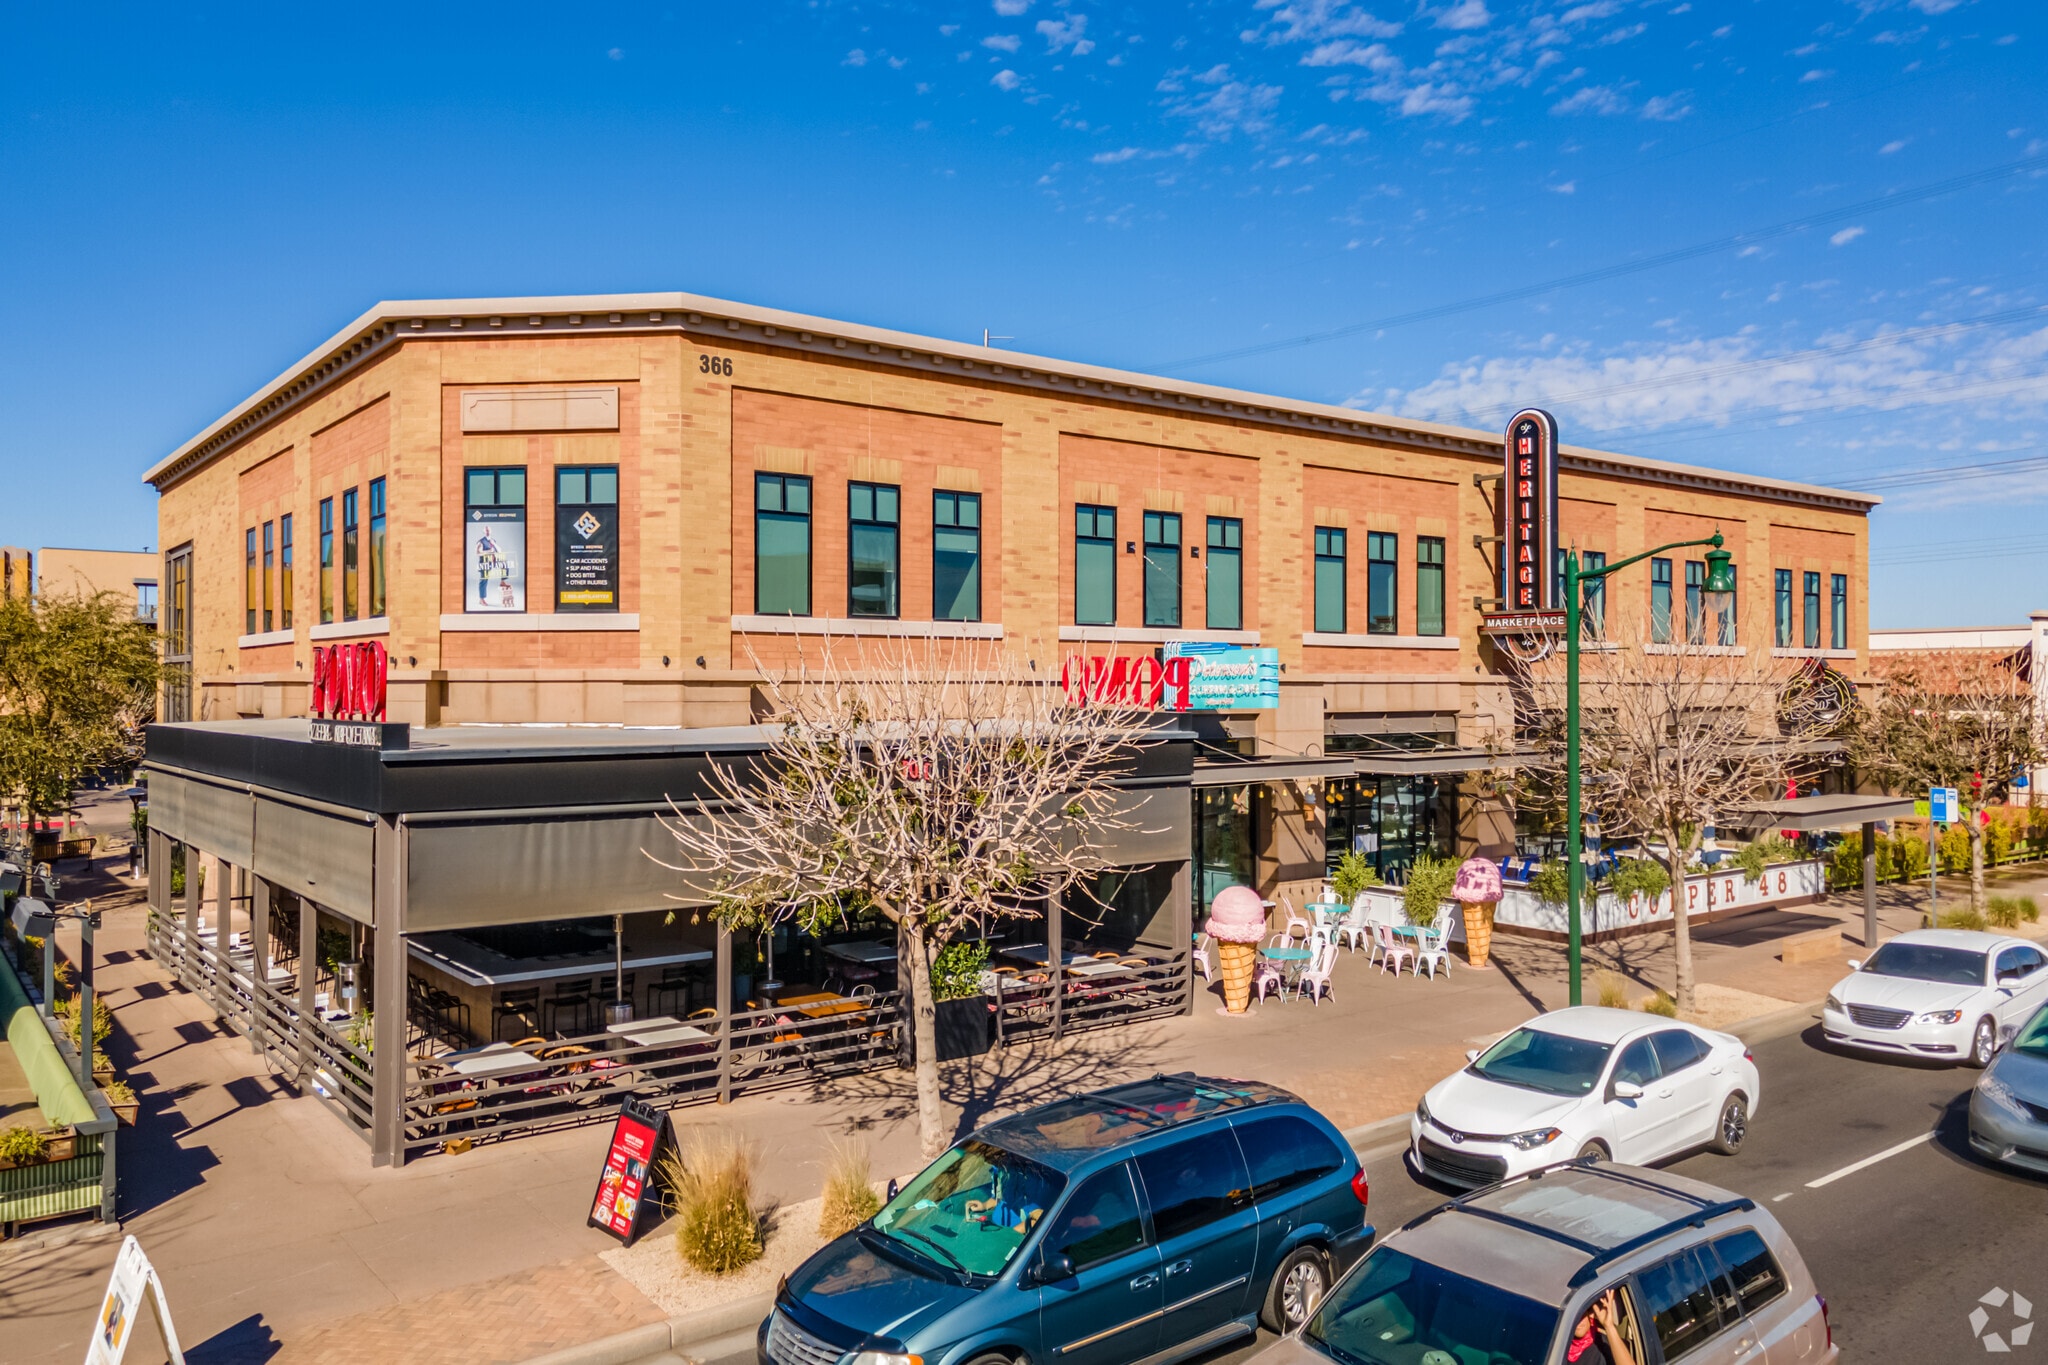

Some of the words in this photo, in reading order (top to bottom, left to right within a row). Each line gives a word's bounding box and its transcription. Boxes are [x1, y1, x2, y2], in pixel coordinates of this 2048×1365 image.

[699, 354, 733, 377] 366
[1518, 437, 1533, 605] HERITAGE
[1487, 616, 1565, 628] MARKETPLACE
[310, 641, 387, 717] POMO
[1759, 871, 1787, 896] 48
